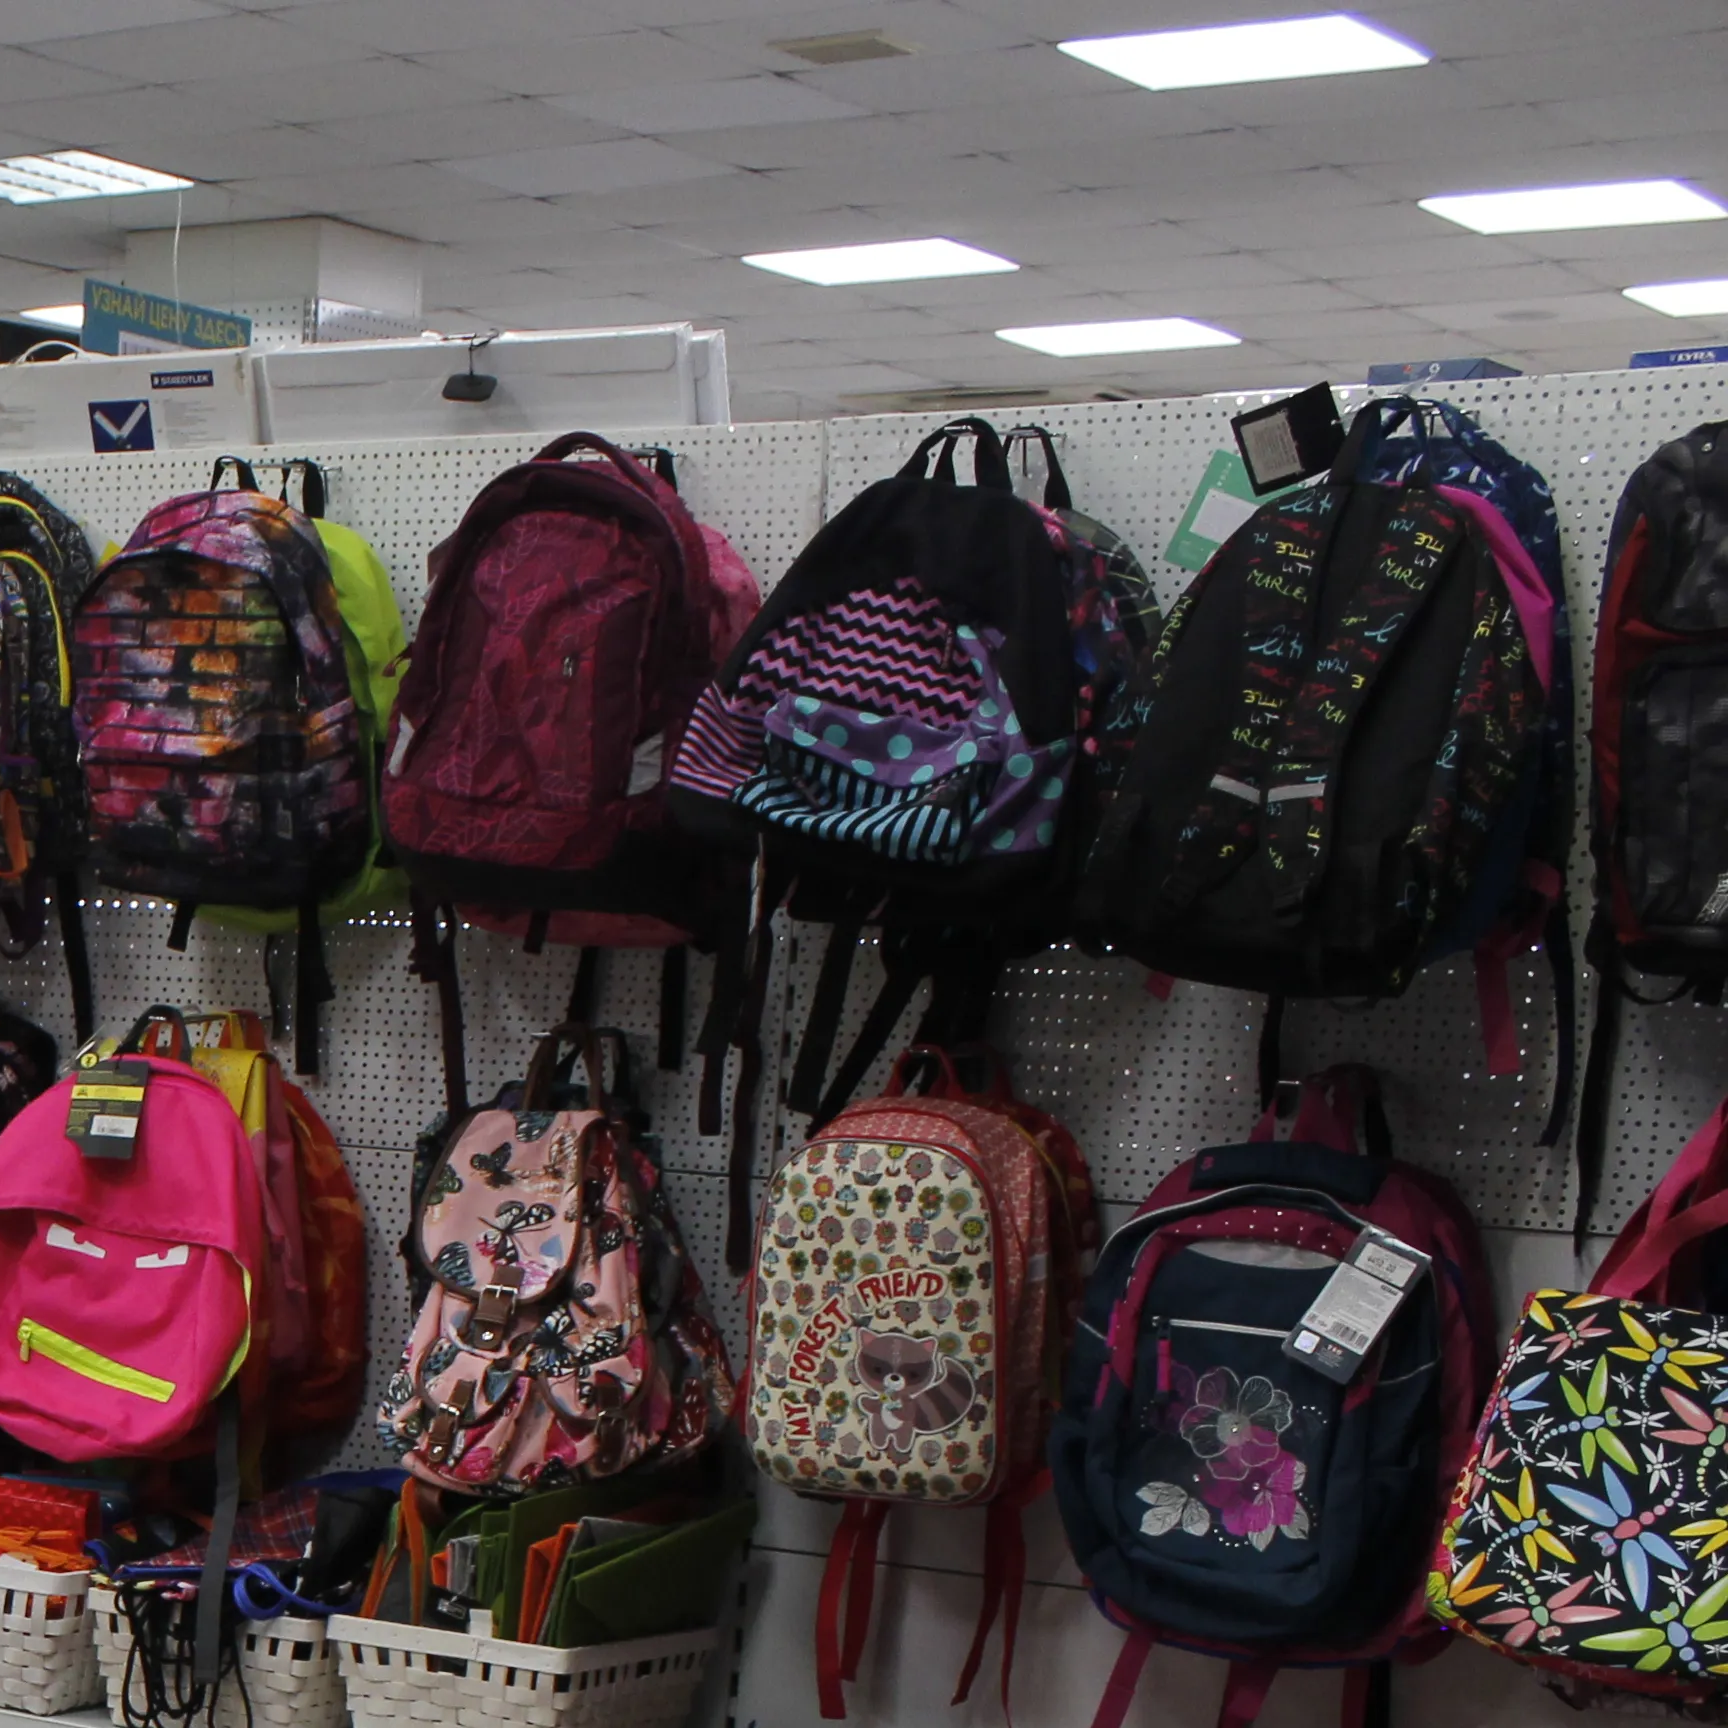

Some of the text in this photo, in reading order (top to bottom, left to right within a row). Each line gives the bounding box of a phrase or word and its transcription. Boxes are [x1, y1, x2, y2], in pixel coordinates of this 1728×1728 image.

[92, 284, 247, 348] УЗНАЙ ЦЕНУ ЗДЕСЬ
[160, 375, 210, 386] STAEDTLER
[784, 1271, 944, 1437] MY FOREST FRIEND
